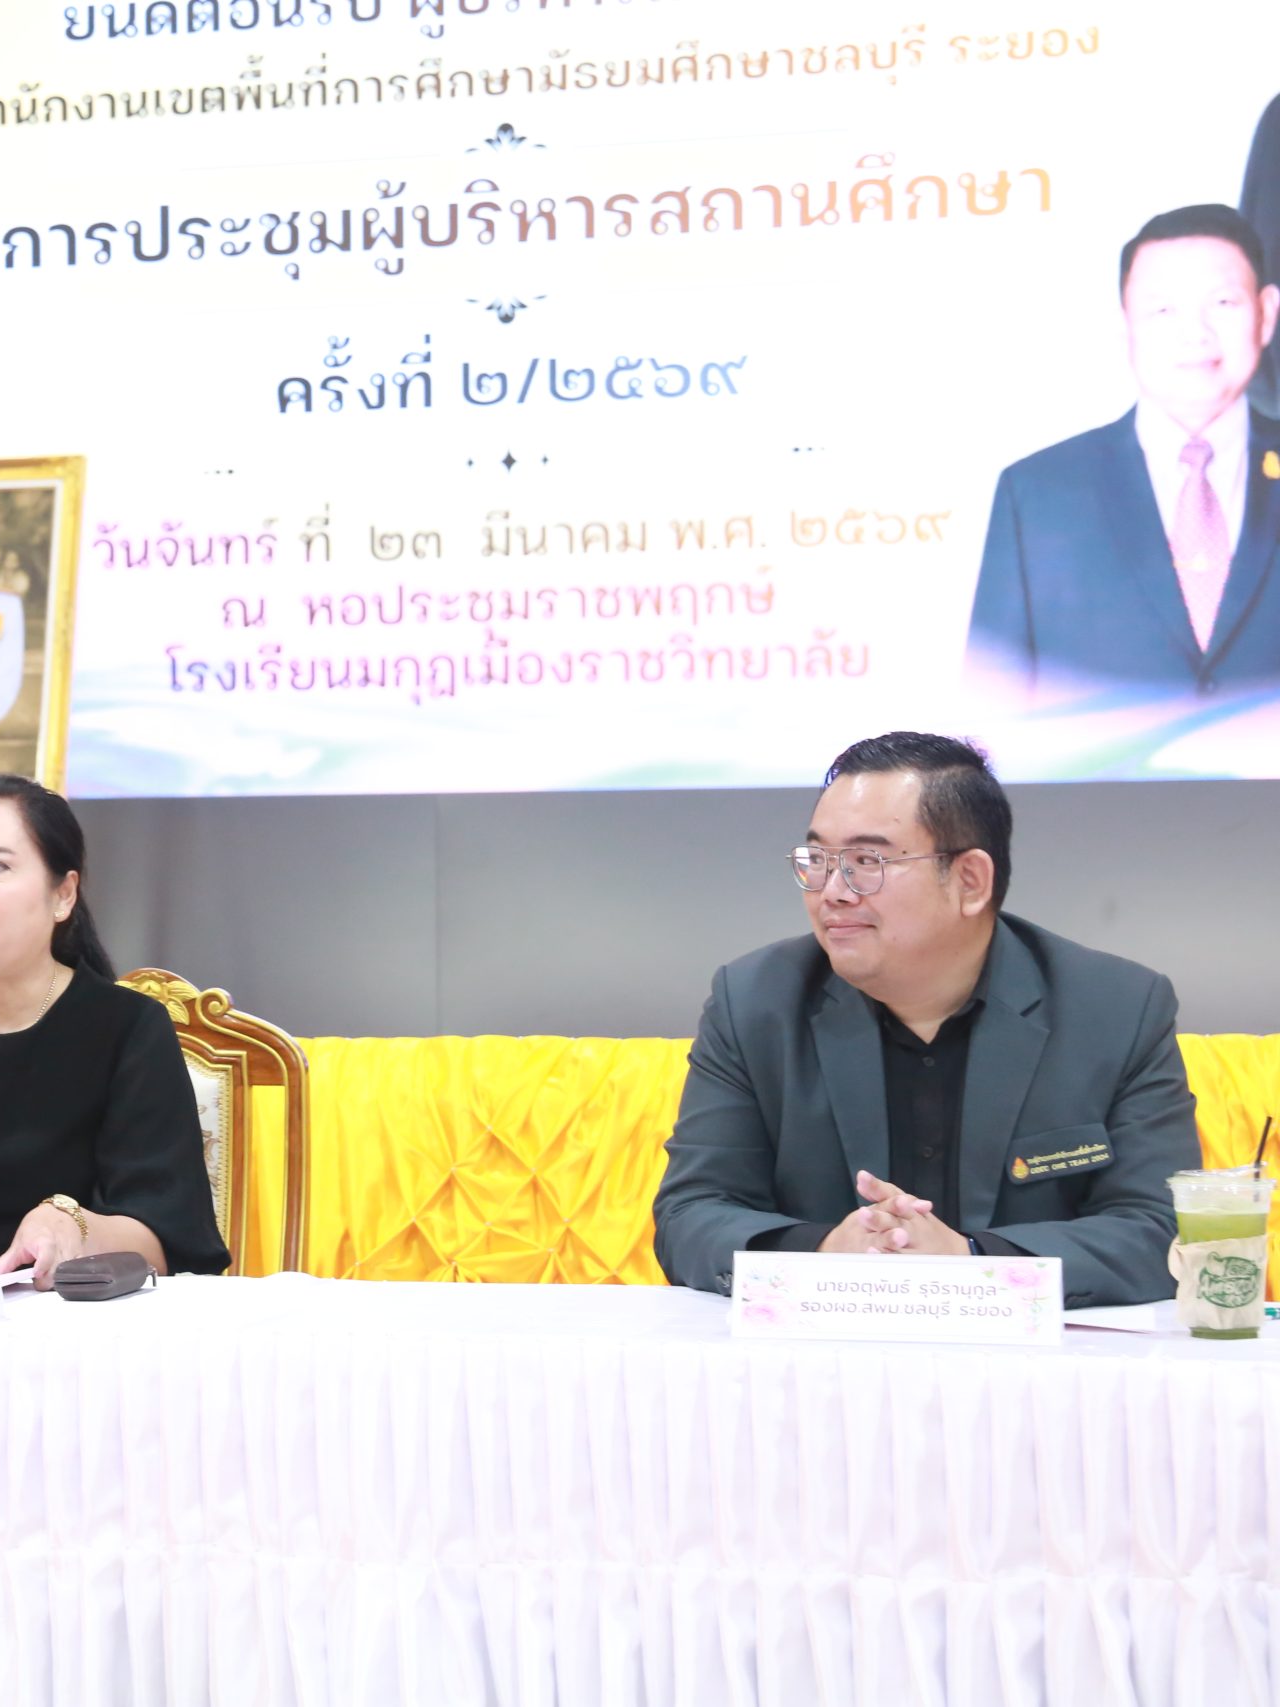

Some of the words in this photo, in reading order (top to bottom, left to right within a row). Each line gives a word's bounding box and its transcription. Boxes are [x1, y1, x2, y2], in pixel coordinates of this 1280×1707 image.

[949, 26, 1100, 64] ระยอง
[2, 151, 1051, 281] การประชุมผู้บริหารสถานศึกษา
[277, 334, 432, 414] ครั้งที่
[461, 355, 748, 406] ๒/๒๕๖๙
[93, 517, 278, 568] วันจันทร์
[299, 503, 331, 562] ที่
[370, 525, 442, 561] ๒๓
[482, 510, 647, 556] มีนาคม
[671, 514, 766, 551] พ.ศ.
[790, 508, 952, 547] ๒๕๖๙
[222, 597, 266, 628] ณ
[303, 566, 776, 641] หอประชุมราชพฤกษ์
[959, 1304, 1013, 1318] ระยอง
